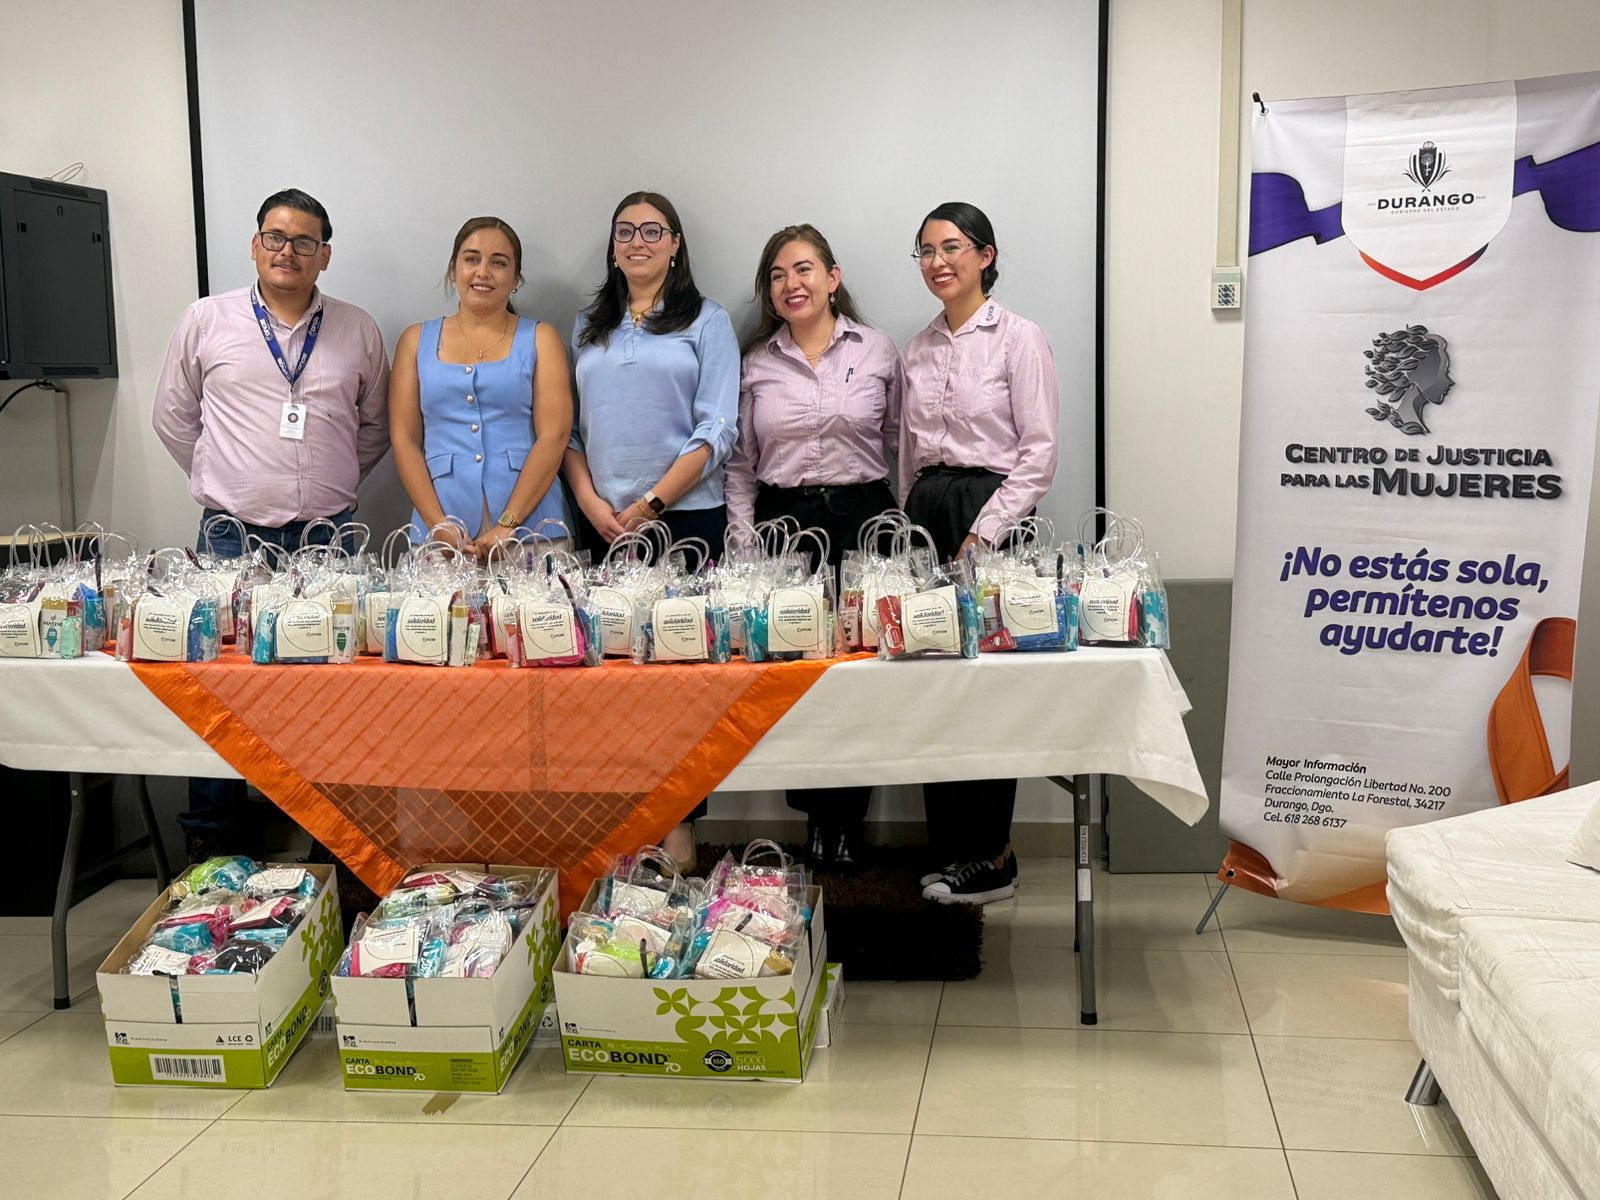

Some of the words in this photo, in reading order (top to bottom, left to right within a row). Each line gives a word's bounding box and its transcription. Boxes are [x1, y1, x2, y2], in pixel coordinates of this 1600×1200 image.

[1377, 193, 1474, 210] DURANGO
[1285, 443, 1388, 465] CENTRO
[1394, 448, 1421, 463] DE
[1426, 445, 1553, 467] JUSTICIA
[1280, 473, 1331, 488] PARA
[1335, 474, 1370, 489] LAS
[1372, 467, 1563, 499] MUJERES
[1280, 546, 1342, 581] ¡No
[1349, 547, 1451, 582] estás
[1456, 553, 1548, 593] sola,
[1304, 582, 1520, 621] permítenos
[779, 607, 811, 615] solidaridad
[1319, 621, 1504, 657] ayudarte!
[1266, 756, 1301, 769] Mayor
[1303, 758, 1367, 774] Información
[1265, 769, 1292, 781] Calle
[1294, 771, 1362, 788] Prolongación
[1363, 778, 1408, 793] Libertad
[1408, 783, 1427, 795] No.
[1428, 785, 1452, 797] 200
[1264, 783, 1350, 800] Fraccionamiento
[1351, 792, 1365, 802] La
[1366, 793, 1412, 810] Forestal,
[1413, 798, 1446, 811] 34217
[1264, 797, 1309, 812] Durango,
[1311, 801, 1334, 814] Dgo.
[1263, 811, 1283, 823] Cel.
[1284, 813, 1301, 824] 618
[1301, 814, 1321, 826] 268
[1322, 817, 1348, 829] 6137
[567, 1039, 602, 1049] CARTA
[345, 1057, 370, 1065] CARTA
[568, 1047, 669, 1065] ECOBOND
[345, 1064, 417, 1076] ECOBOND
[737, 1064, 767, 1072] HOJAS
